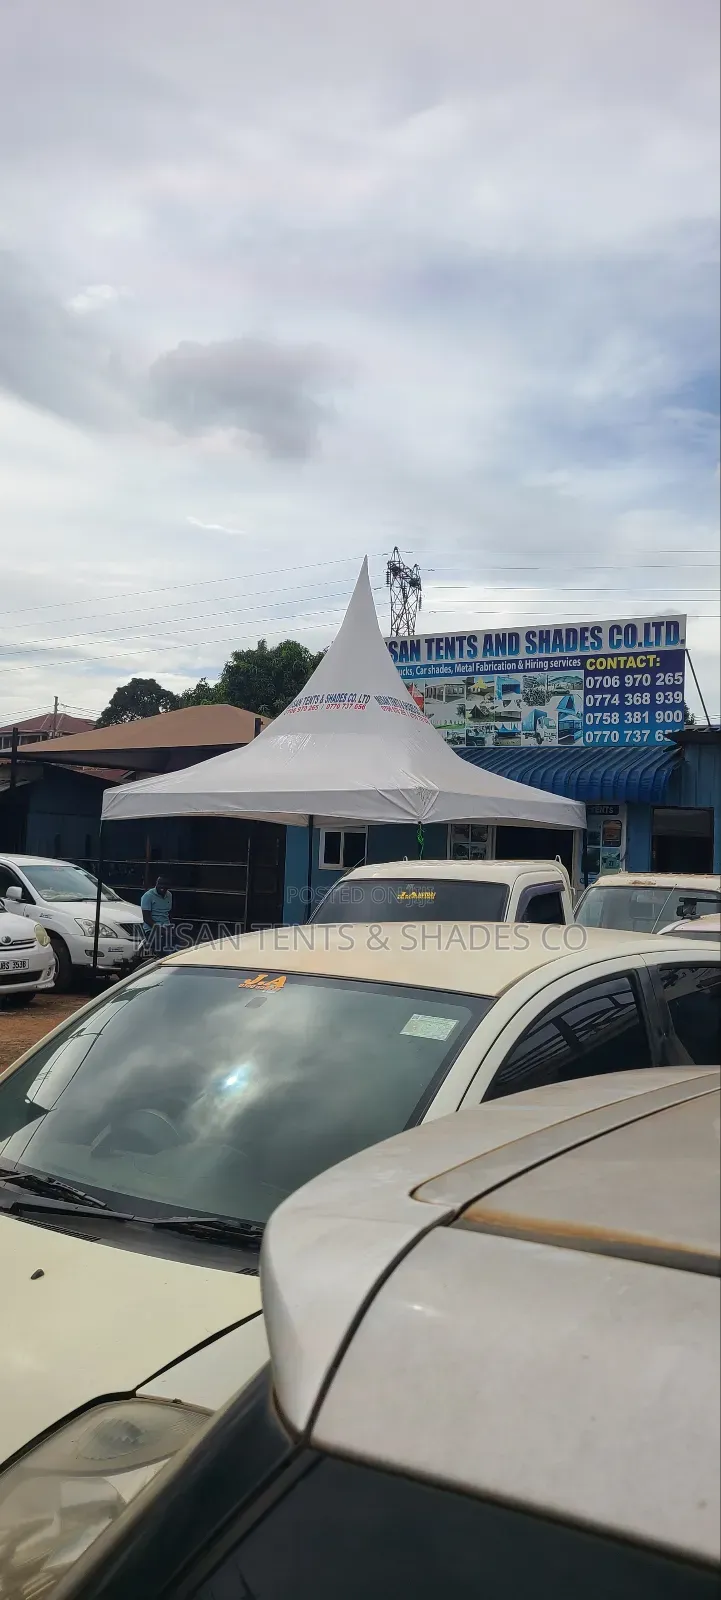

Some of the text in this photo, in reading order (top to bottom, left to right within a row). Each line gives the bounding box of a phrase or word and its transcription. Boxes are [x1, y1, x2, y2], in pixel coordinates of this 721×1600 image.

[425, 634, 479, 661] TENTS
[482, 631, 520, 658] AND
[525, 625, 603, 656] SHADES
[608, 620, 686, 651] CO.LTD.
[399, 656, 581, 677] ucks, Car shades, Metal Fabrication & Hiring services
[586, 654, 661, 671] CONTACT:
[586, 672, 683, 689] 0706 970 265
[302, 694, 320, 706] TENTS
[325, 693, 348, 704] SHADES
[358, 694, 370, 704] LTD
[586, 691, 683, 707] 0774 368 939
[586, 710, 682, 725] 0758 381 900
[585, 729, 680, 743] 0770 737 65
